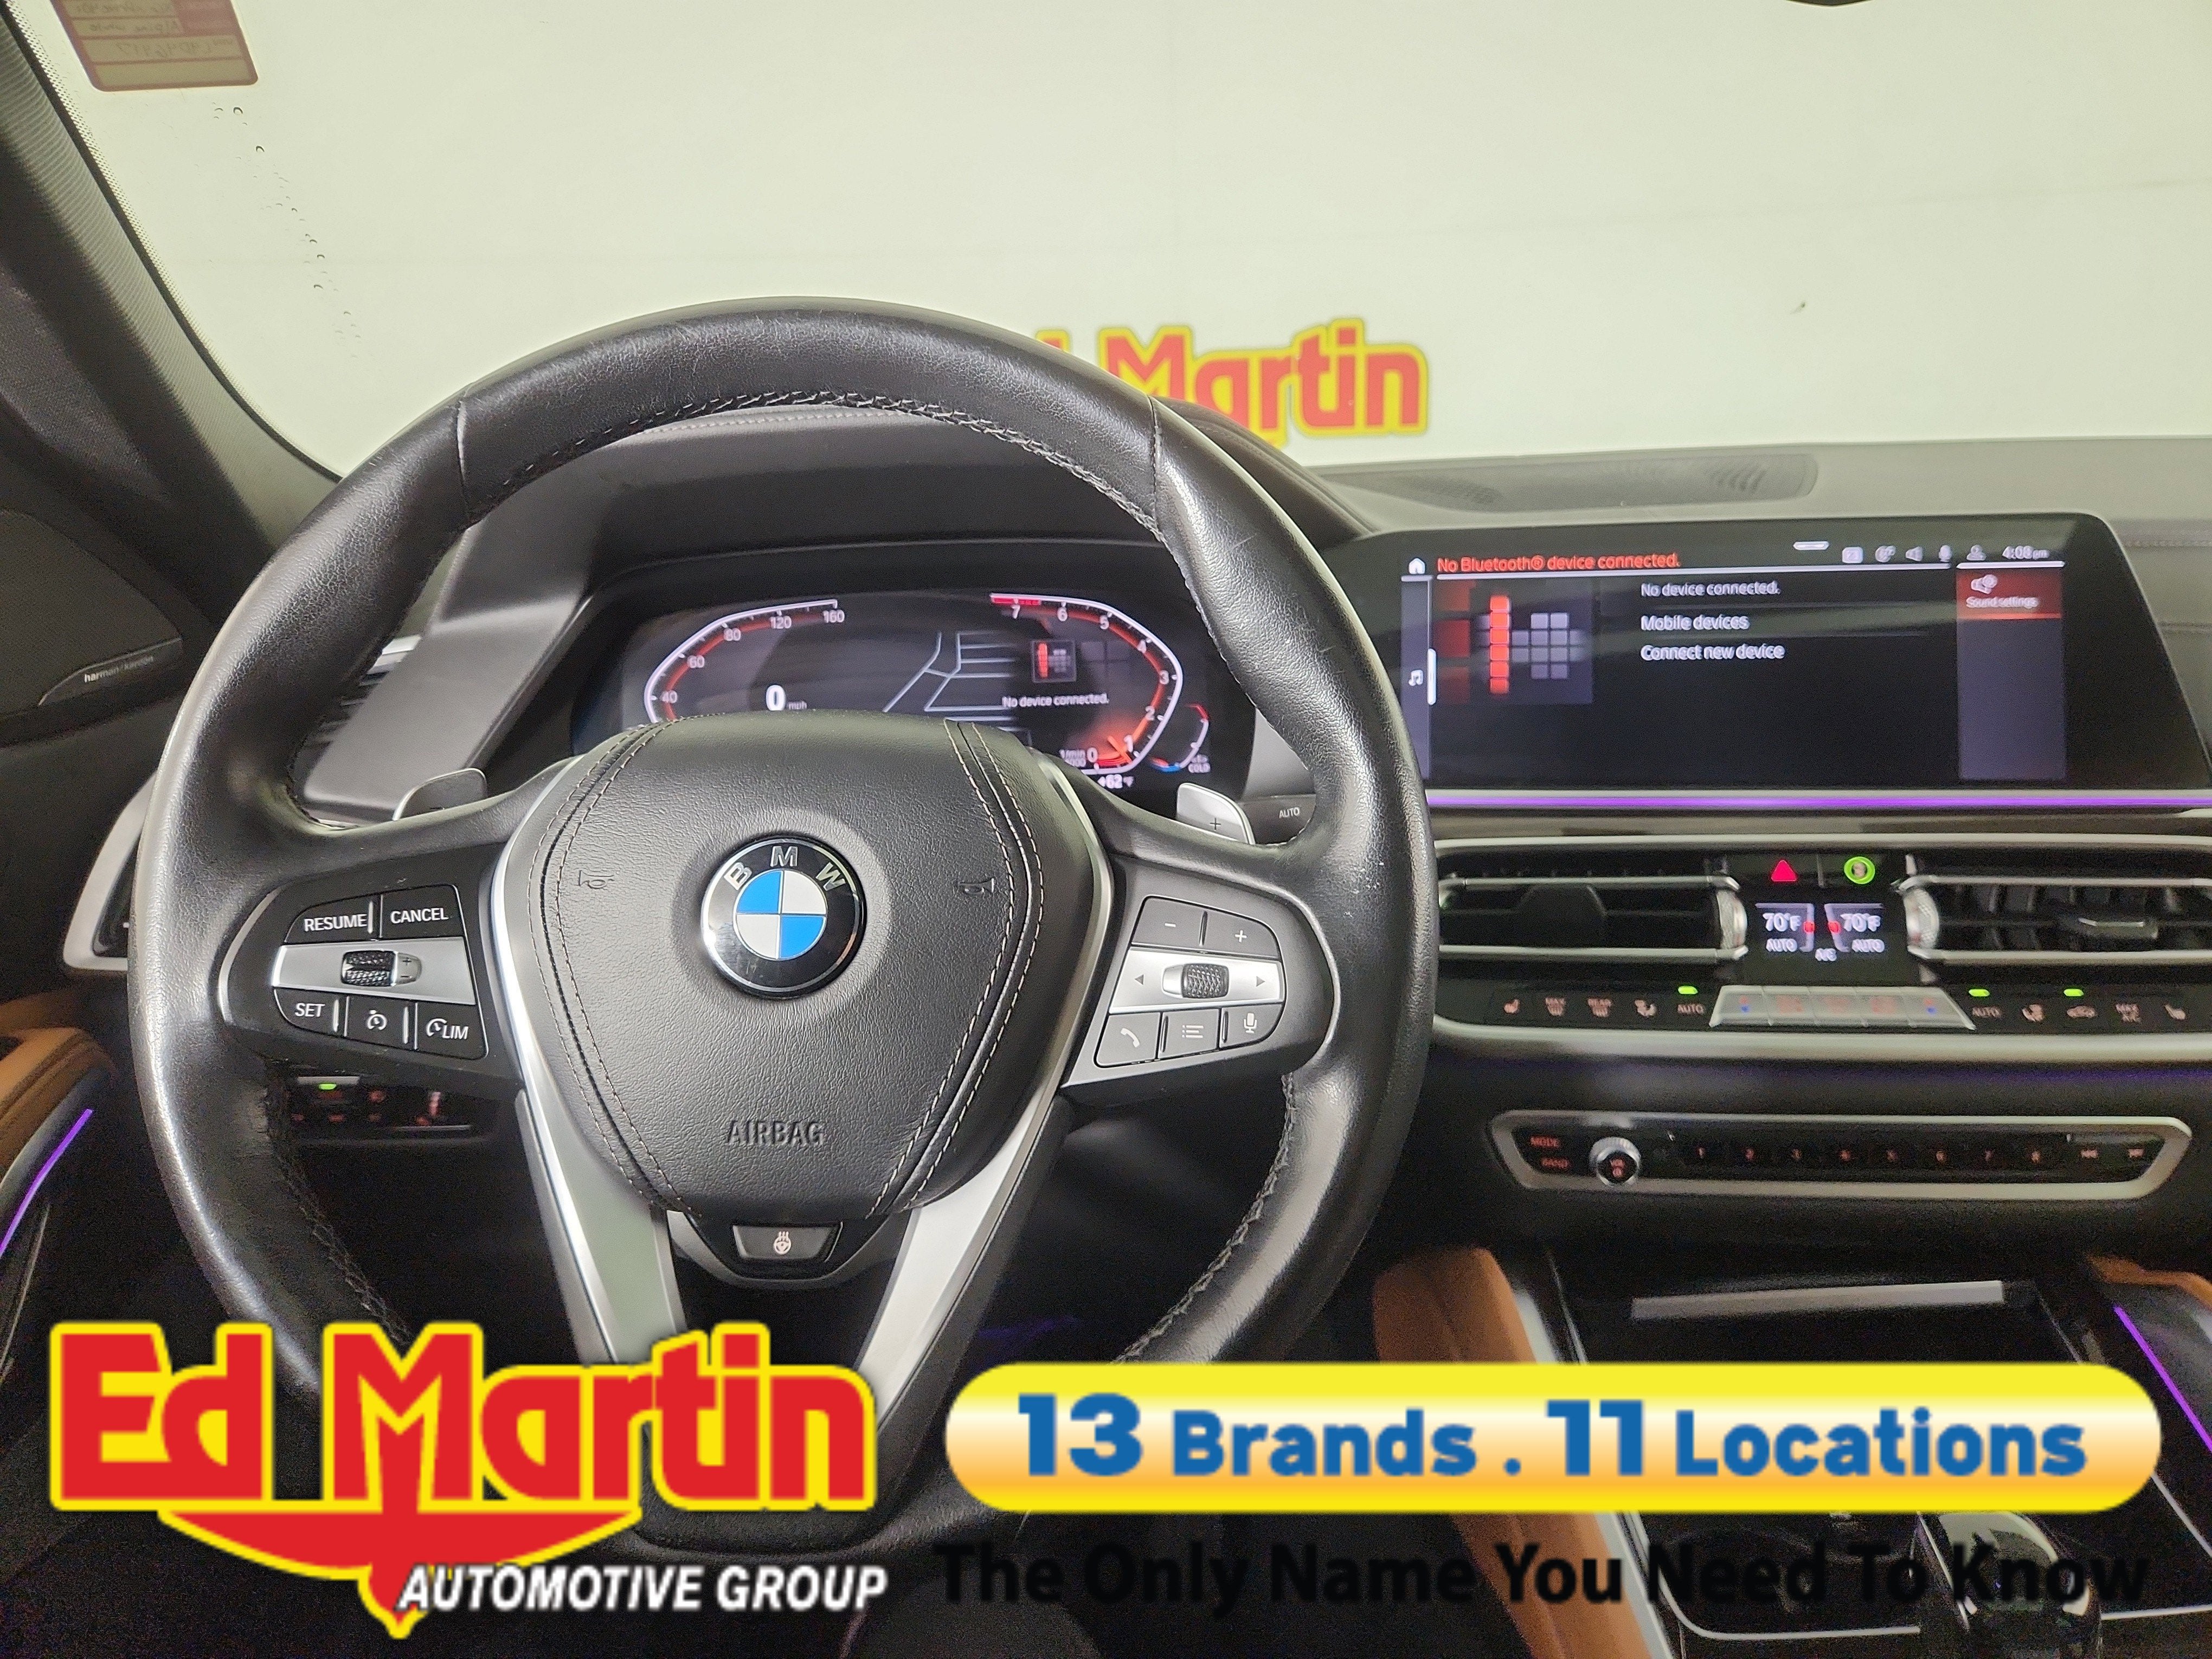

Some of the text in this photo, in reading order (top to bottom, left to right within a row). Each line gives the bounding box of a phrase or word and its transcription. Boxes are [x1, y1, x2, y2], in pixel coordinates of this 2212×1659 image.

[1437, 558, 1457, 573] No
[1547, 555, 1594, 570] device
[1597, 552, 1680, 568] connected.
[1641, 581, 1780, 596] No device connected.
[823, 609, 845, 623] 160
[1012, 606, 1021, 619] 7
[1058, 608, 1067, 621] 6
[770, 616, 792, 629] 120
[1100, 616, 1110, 629] 5
[1641, 614, 1750, 631] Mobile devices
[724, 628, 741, 641] 80
[1137, 640, 1147, 652] 4
[1641, 644, 1785, 660] Connect new device
[687, 655, 704, 668] 60
[1160, 670, 1169, 684] 3
[660, 691, 677, 704] 40
[766, 685, 786, 711] 0
[1002, 693, 1109, 708] No device connected.
[1146, 707, 1155, 720] 2
[1087, 747, 1098, 762] 0
[1279, 806, 1300, 818] AUTO
[723, 845, 846, 890] BMW
[304, 914, 367, 932] RESUME
[390, 908, 449, 924] CANCEL
[1766, 938, 1798, 953] AUTO
[295, 1002, 325, 1018] SET
[442, 1024, 469, 1039] LIM
[726, 1119, 826, 1147] AIRBAG
